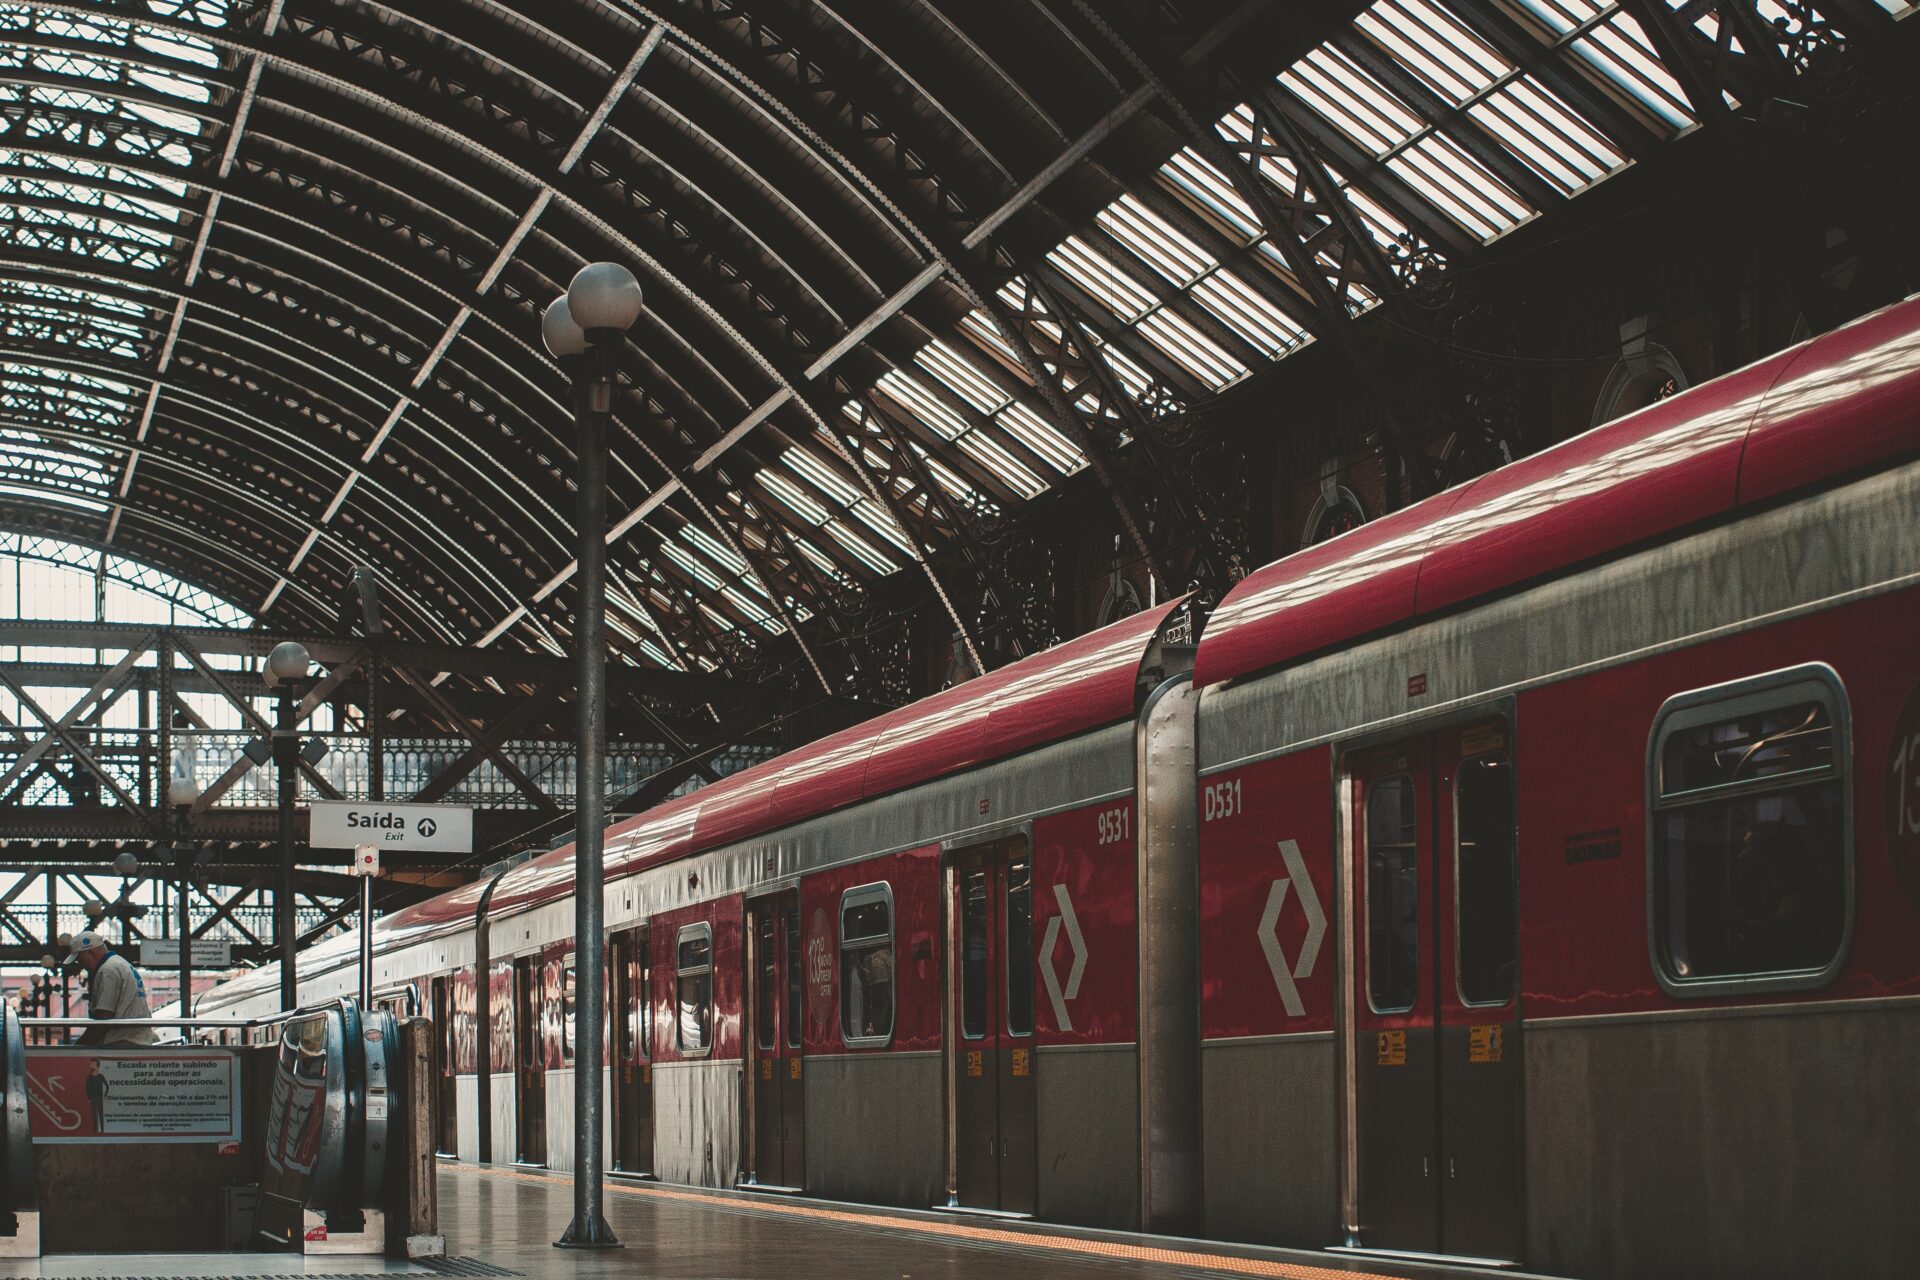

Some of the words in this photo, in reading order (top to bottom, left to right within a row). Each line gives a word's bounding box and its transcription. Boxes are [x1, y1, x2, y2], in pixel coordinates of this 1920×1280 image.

[1205, 778, 1241, 822] D531
[347, 811, 405, 829] Saída
[1098, 806, 1129, 845] 9531
[385, 832, 404, 841] Exit
[820, 969, 832, 983] TREM
[117, 1061, 146, 1069] Escada
[149, 1061, 180, 1069] rolante
[182, 1061, 218, 1069] subindo
[109, 1078, 166, 1086] necessidades
[168, 1078, 226, 1086] operacionais.
[375, 1107, 381, 1116] 4
